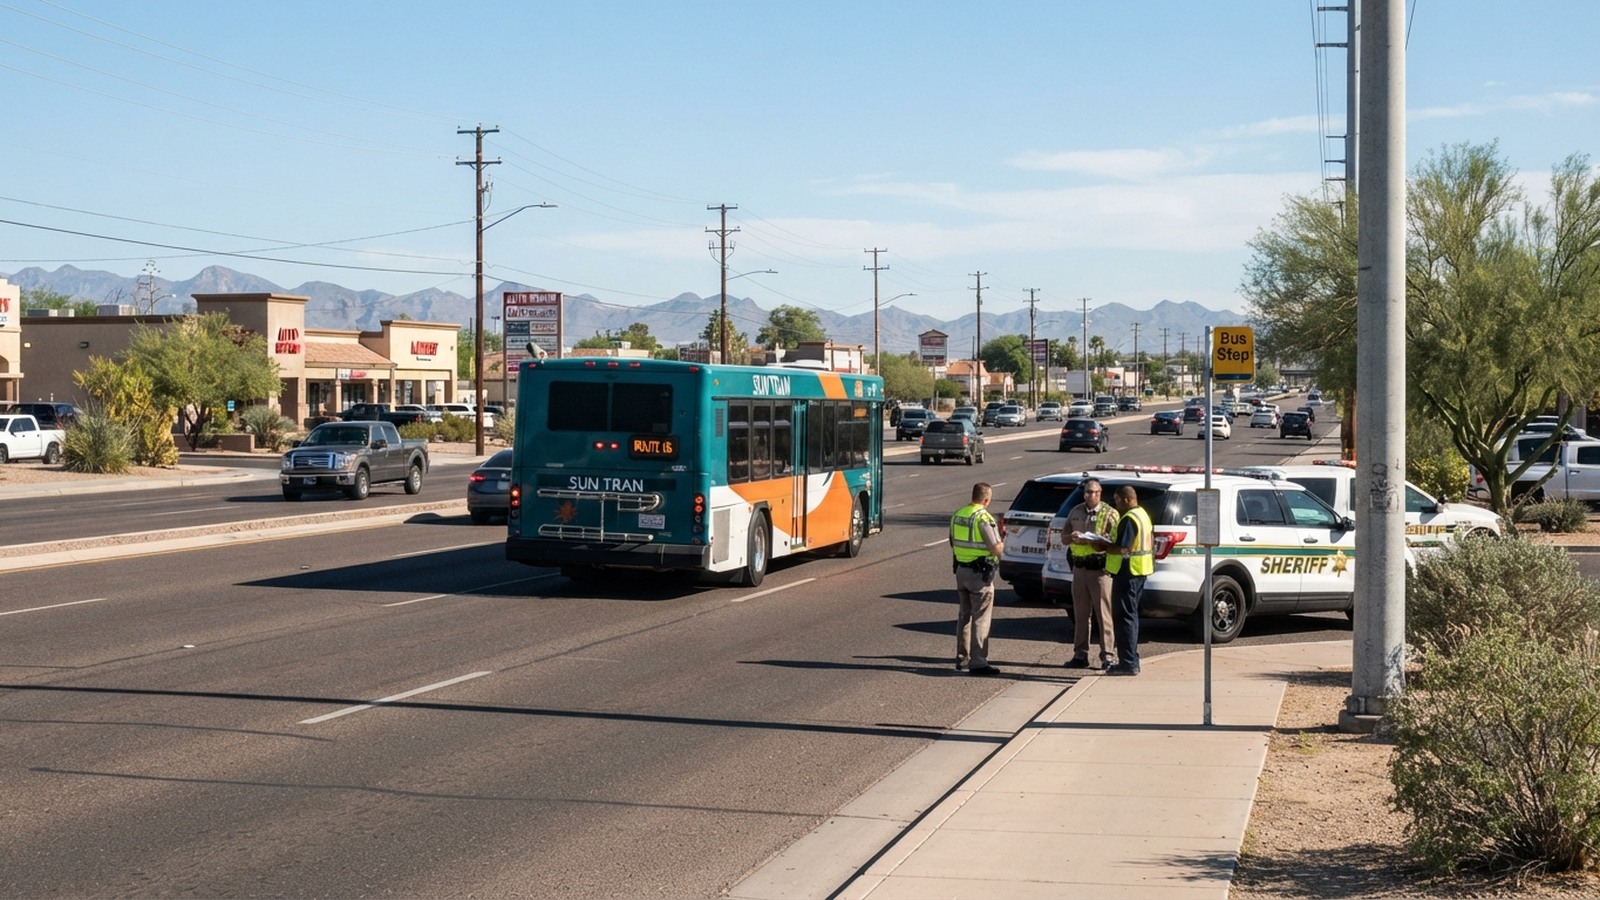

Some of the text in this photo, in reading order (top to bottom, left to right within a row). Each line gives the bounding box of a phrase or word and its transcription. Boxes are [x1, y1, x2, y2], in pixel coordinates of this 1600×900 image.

[1220, 332, 1247, 345] Bus
[568, 476, 644, 493] SUN TRAN
[1260, 556, 1329, 574] SHERIFF
